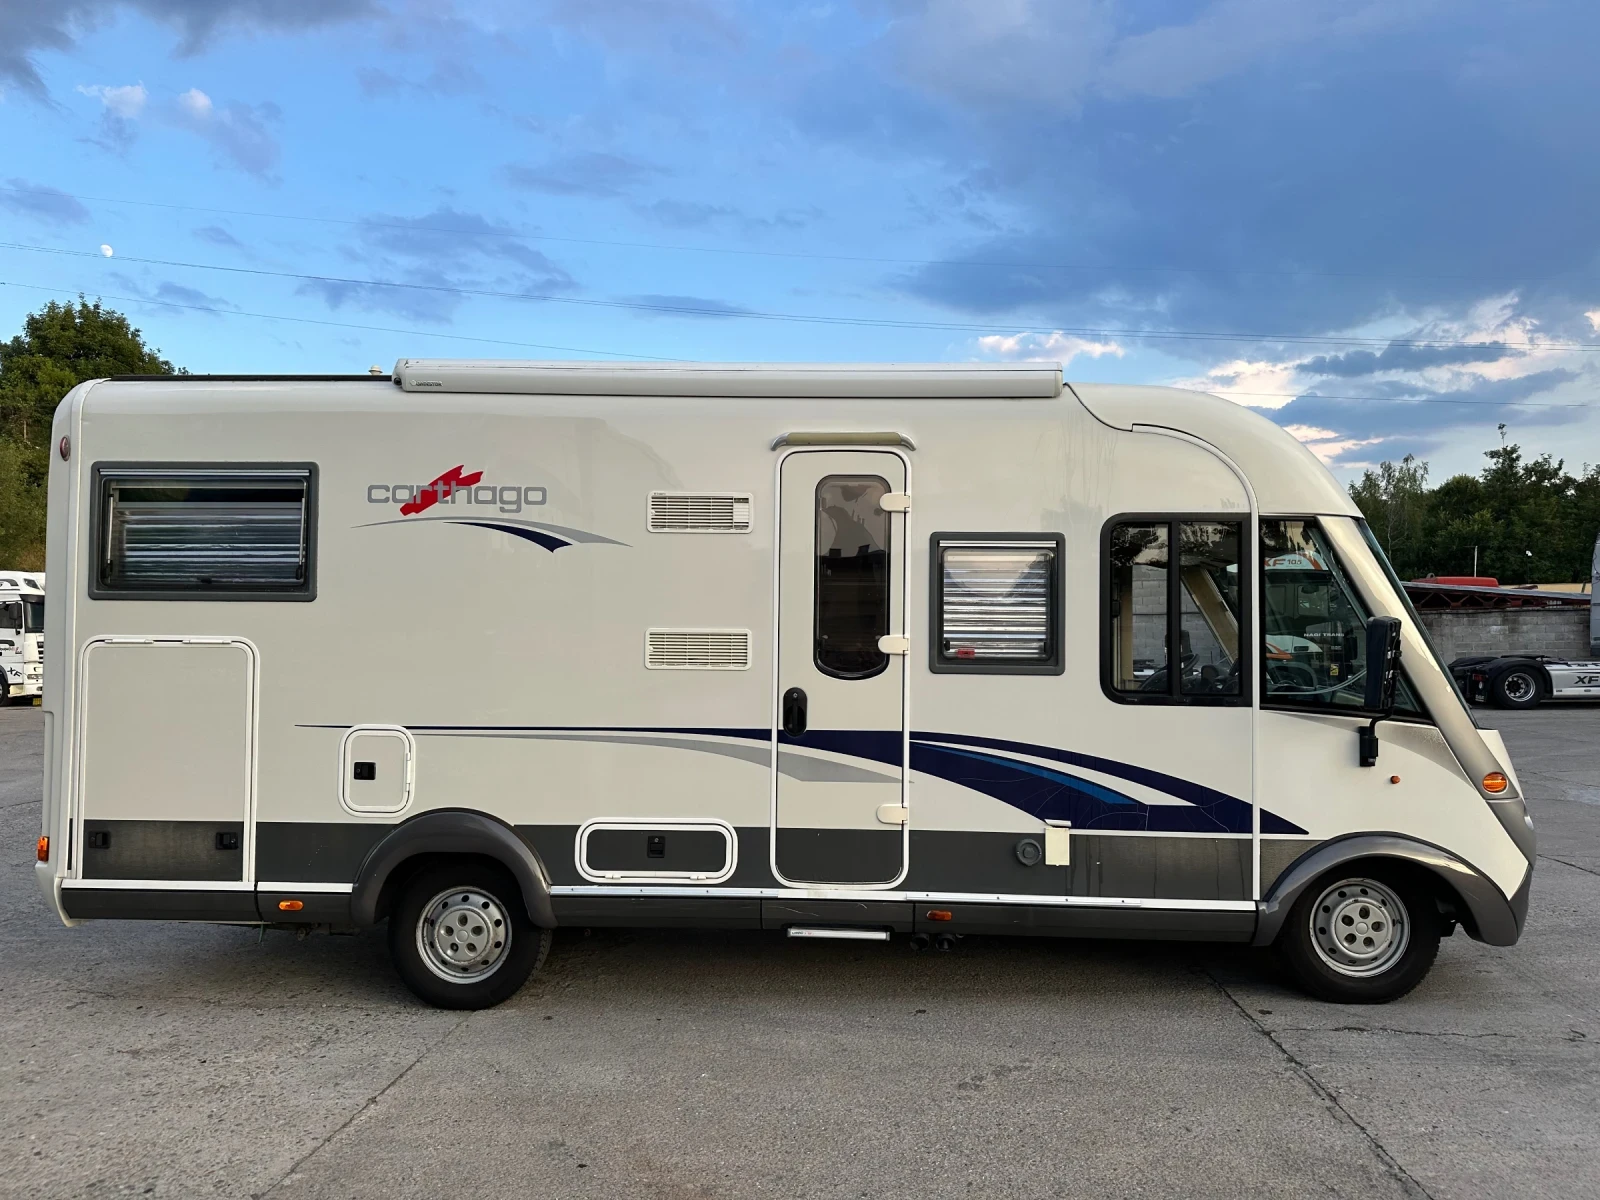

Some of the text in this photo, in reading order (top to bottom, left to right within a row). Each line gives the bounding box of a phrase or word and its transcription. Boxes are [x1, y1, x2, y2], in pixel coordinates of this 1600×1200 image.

[367, 480, 547, 513] carthago
[7, 667, 22, 677] XF
[1574, 676, 1600, 684] XF
